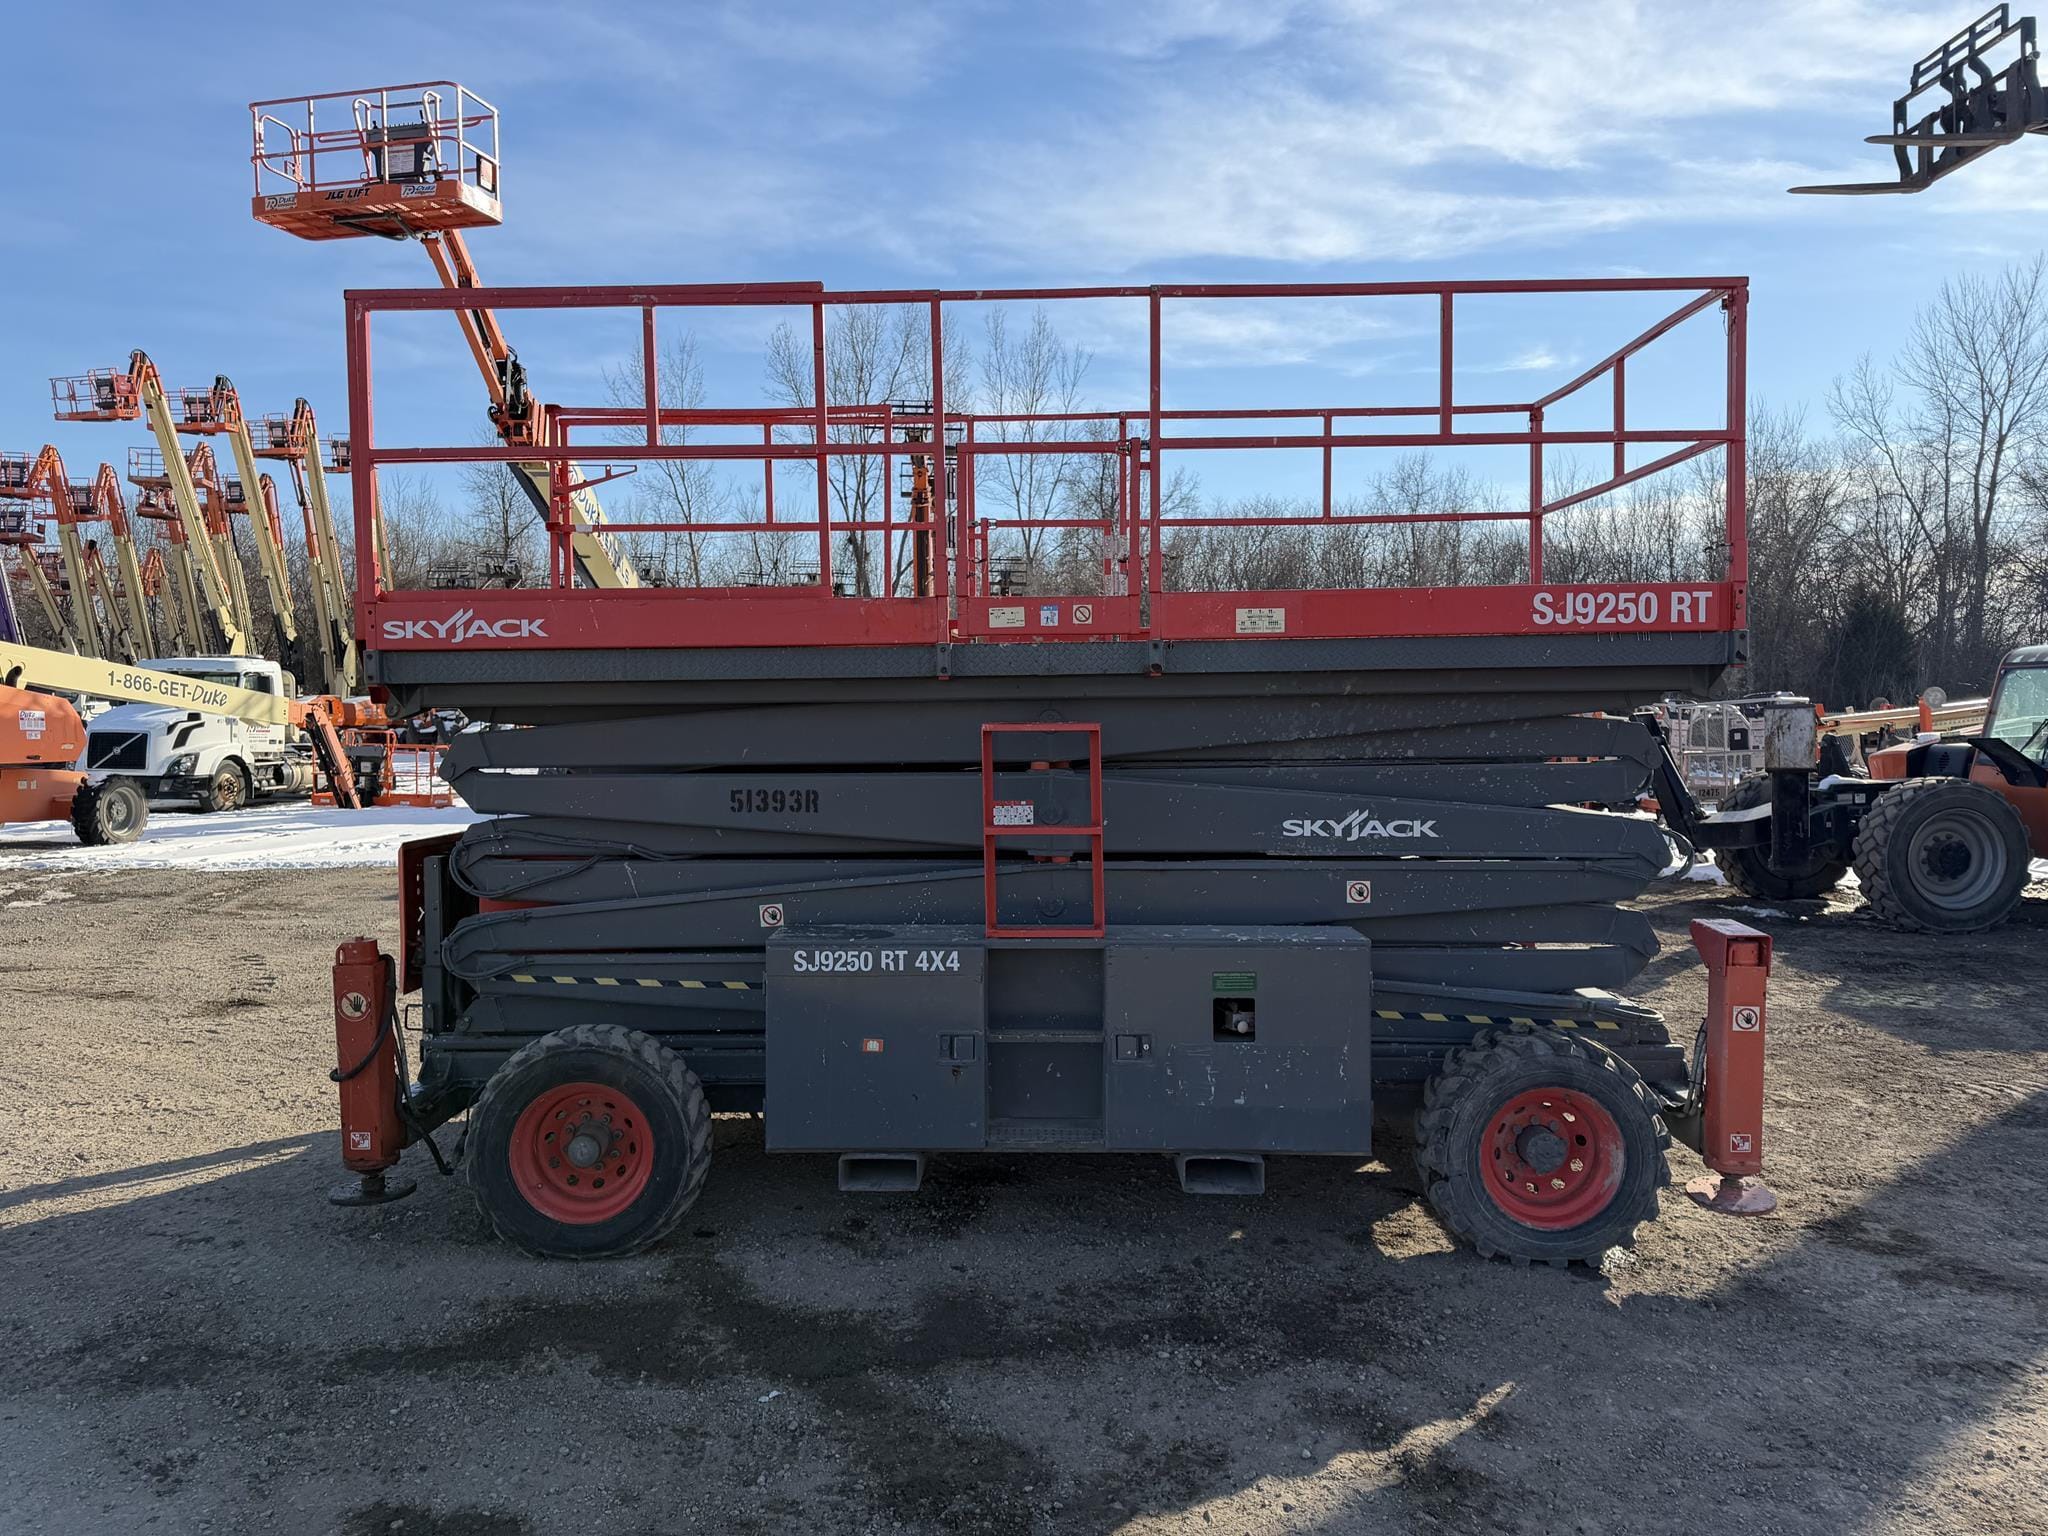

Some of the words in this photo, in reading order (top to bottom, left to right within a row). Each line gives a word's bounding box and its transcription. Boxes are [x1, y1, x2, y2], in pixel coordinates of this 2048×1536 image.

[325, 191, 344, 200] JLG
[347, 188, 370, 198] LIFT
[1532, 591, 1658, 625] SJ9250
[1670, 591, 1712, 623] RT
[382, 608, 549, 644] SKYJACK
[108, 670, 228, 707] 1-866-GET-Duke
[729, 789, 820, 813] 51393R
[1282, 809, 1439, 842] SKYJACK
[793, 950, 873, 972] SJ9250
[881, 950, 909, 972] RT
[915, 950, 961, 972] 4X4
